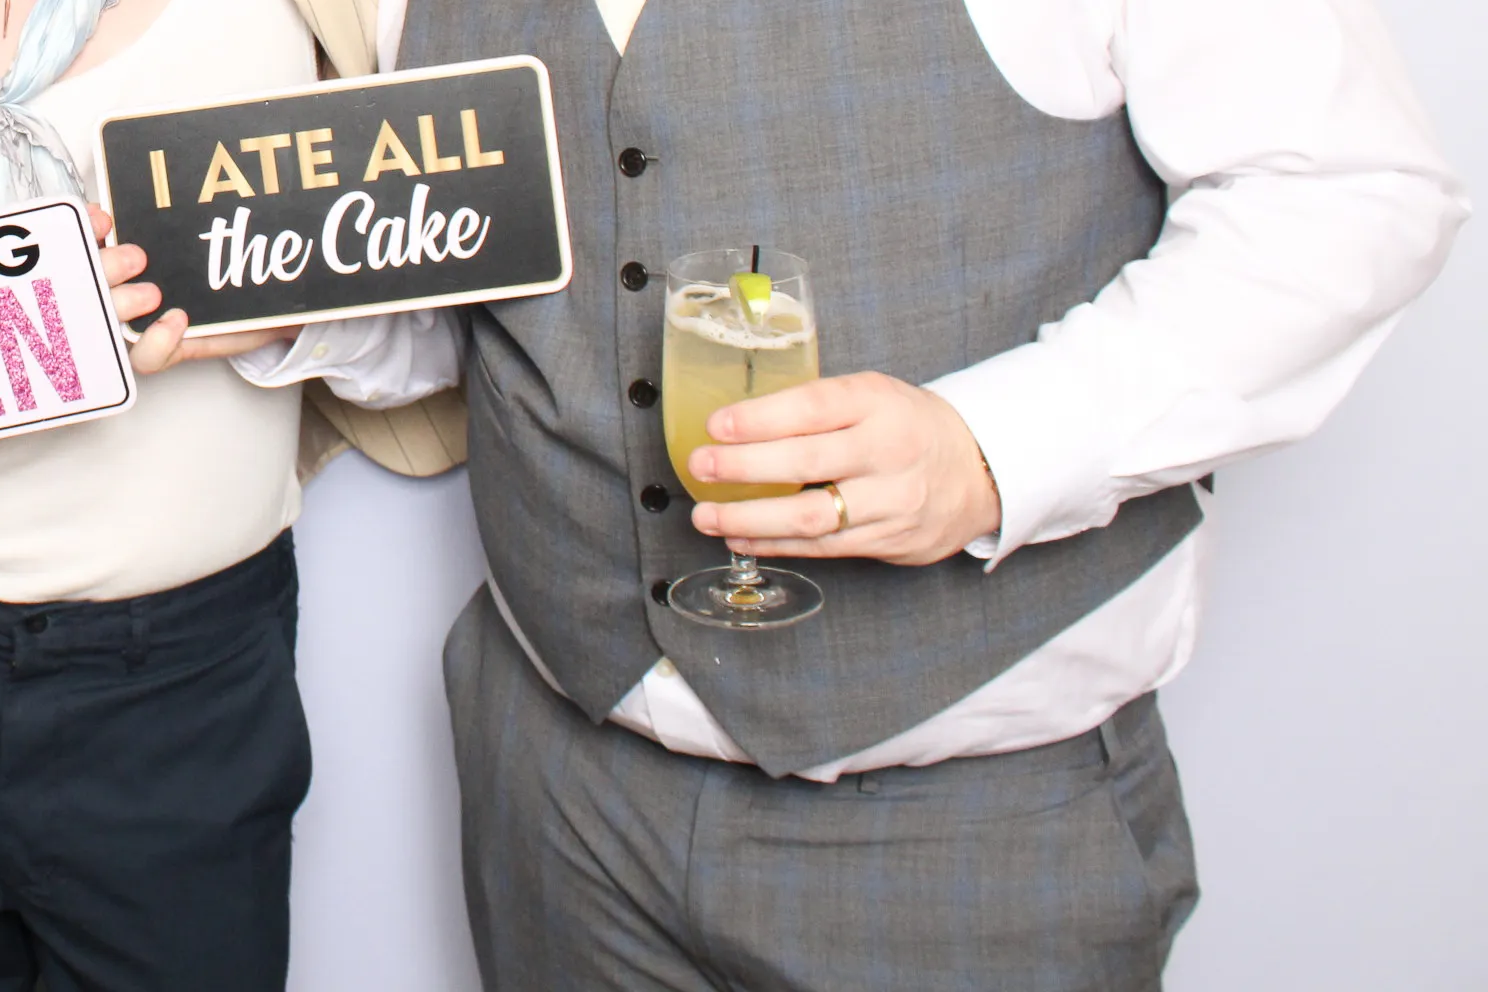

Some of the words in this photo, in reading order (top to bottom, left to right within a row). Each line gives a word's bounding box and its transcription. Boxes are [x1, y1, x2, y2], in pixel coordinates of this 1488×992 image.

[149, 149, 172, 208] I
[197, 127, 340, 204] ATE
[362, 108, 505, 182] ALL
[198, 206, 313, 291] the
[321, 182, 491, 275] Cake
